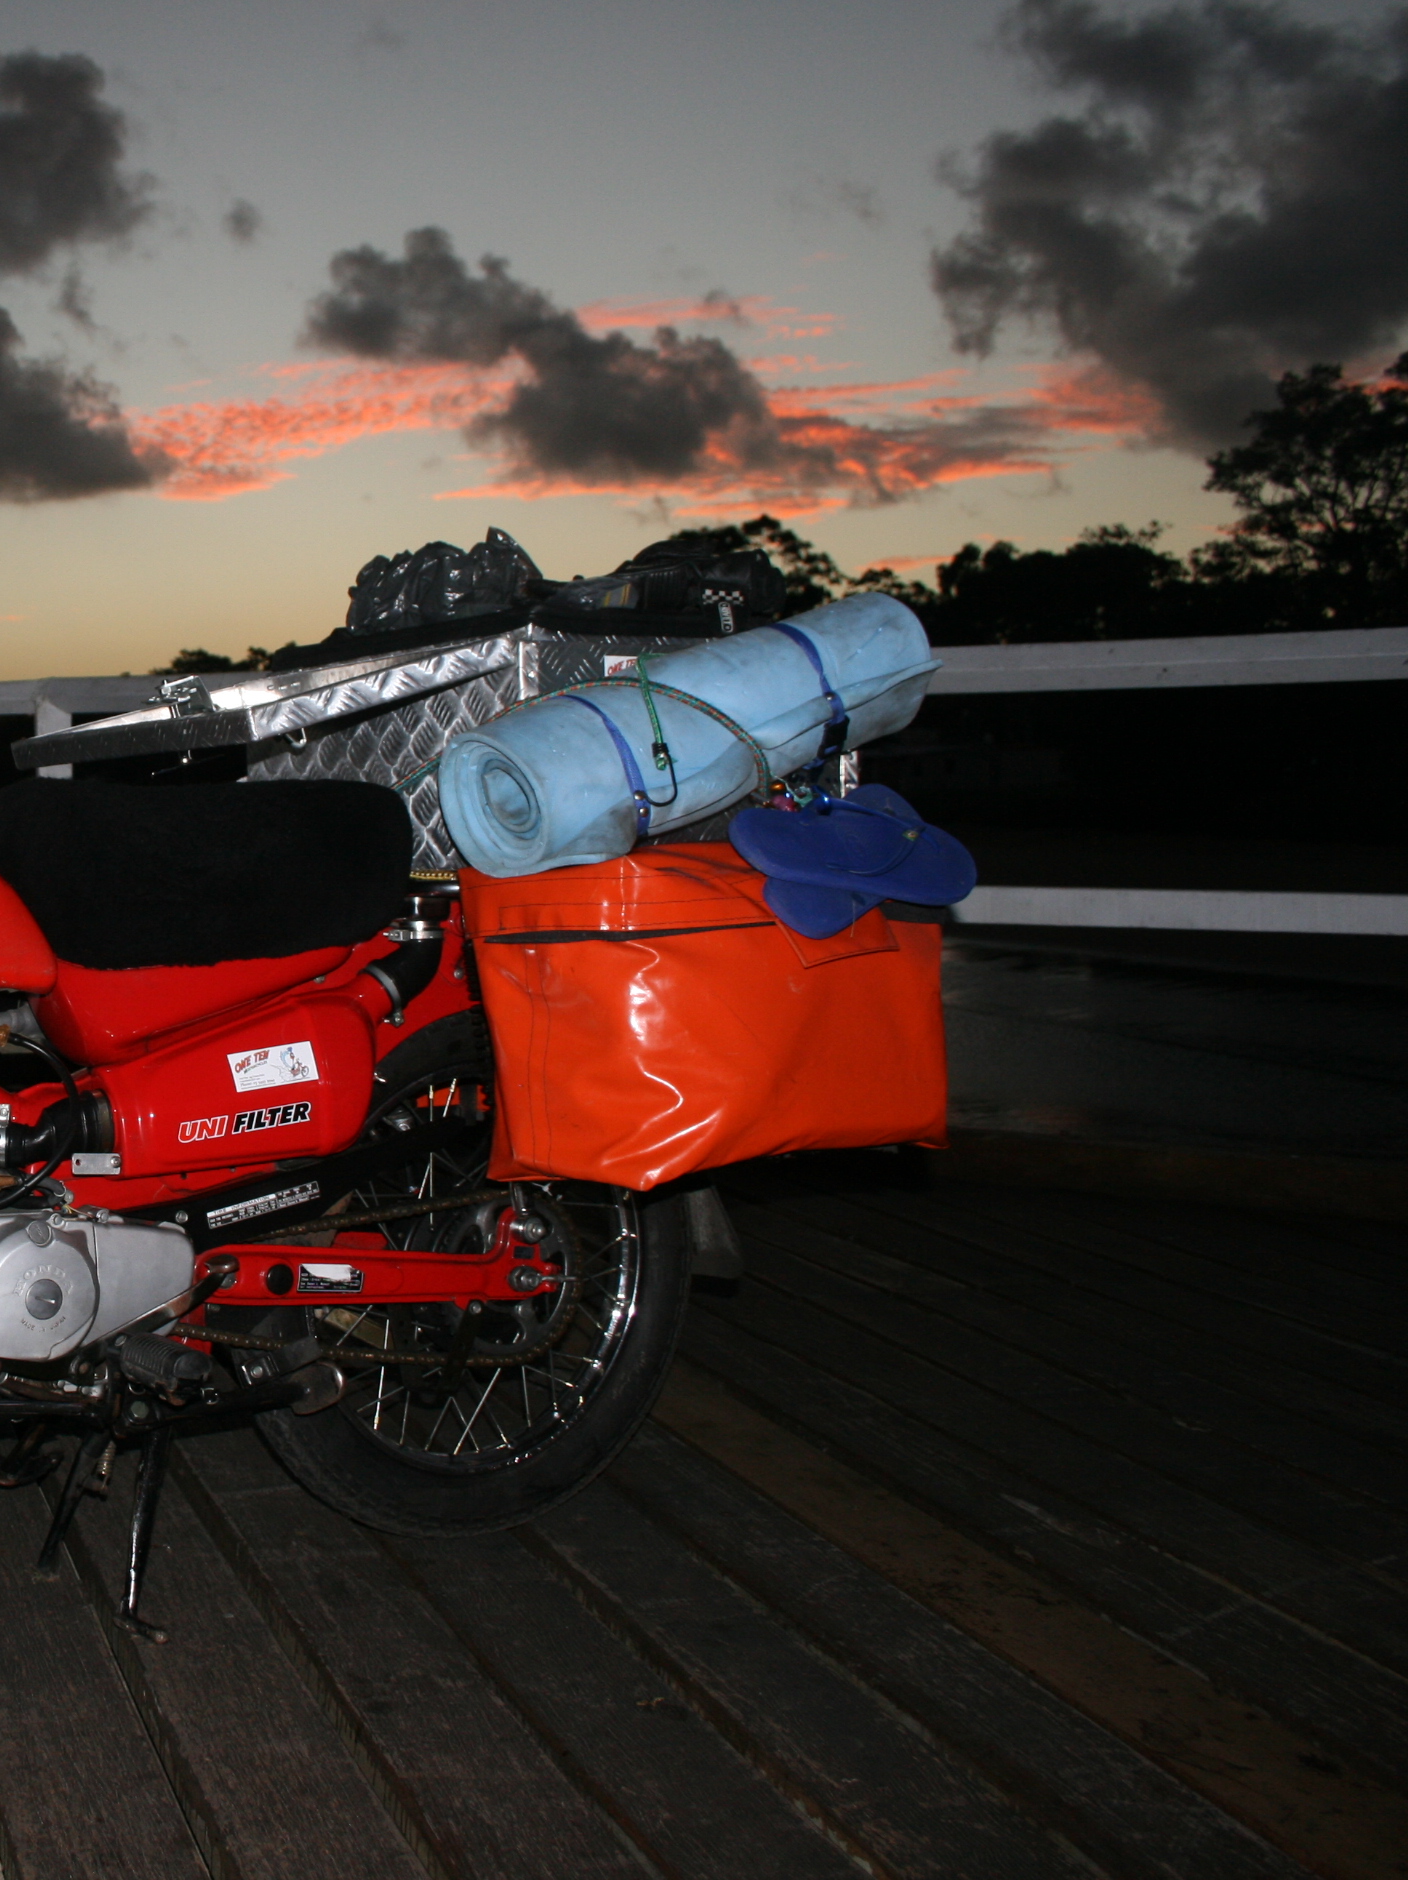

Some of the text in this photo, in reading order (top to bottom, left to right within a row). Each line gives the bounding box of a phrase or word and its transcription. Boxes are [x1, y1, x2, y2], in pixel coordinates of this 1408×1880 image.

[235, 1049, 270, 1073] ONE TEN
[178, 1101, 312, 1144] UNI FILTER
